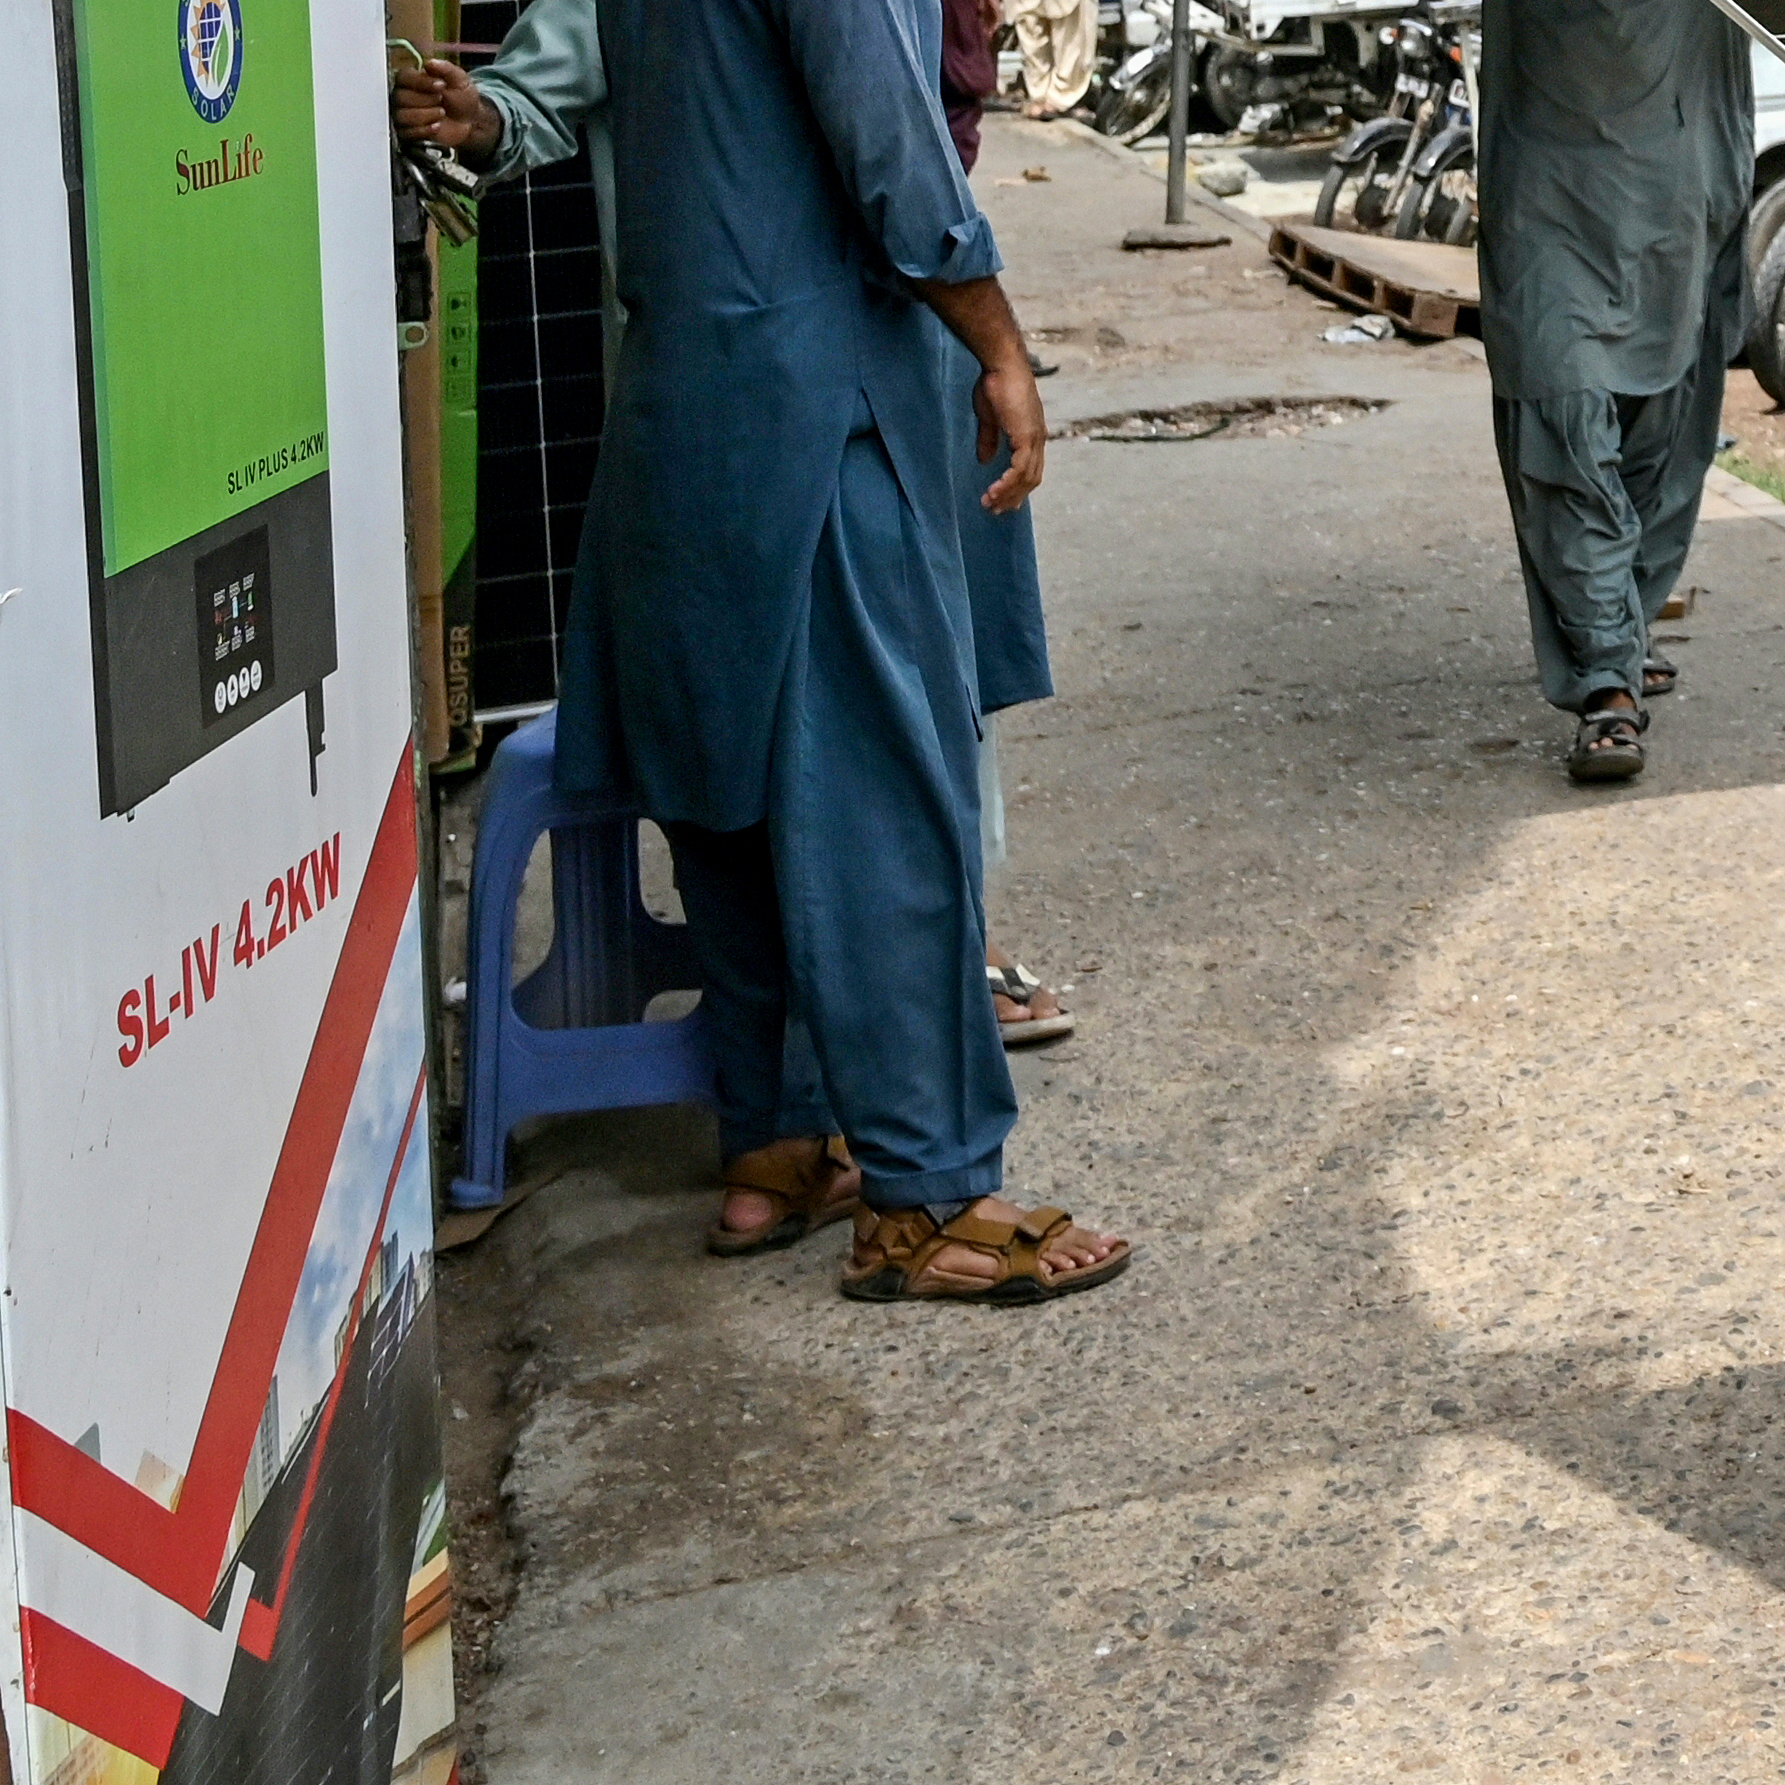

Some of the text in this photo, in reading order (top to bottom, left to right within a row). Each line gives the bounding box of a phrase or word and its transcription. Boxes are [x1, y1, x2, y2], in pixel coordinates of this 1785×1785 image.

[190, 83, 236, 121] SOLAR
[176, 132, 264, 196] SunLife
[227, 430, 324, 494] SL IV PLUS 4.2KW
[117, 831, 341, 1068] SL-IV 4.2KW
